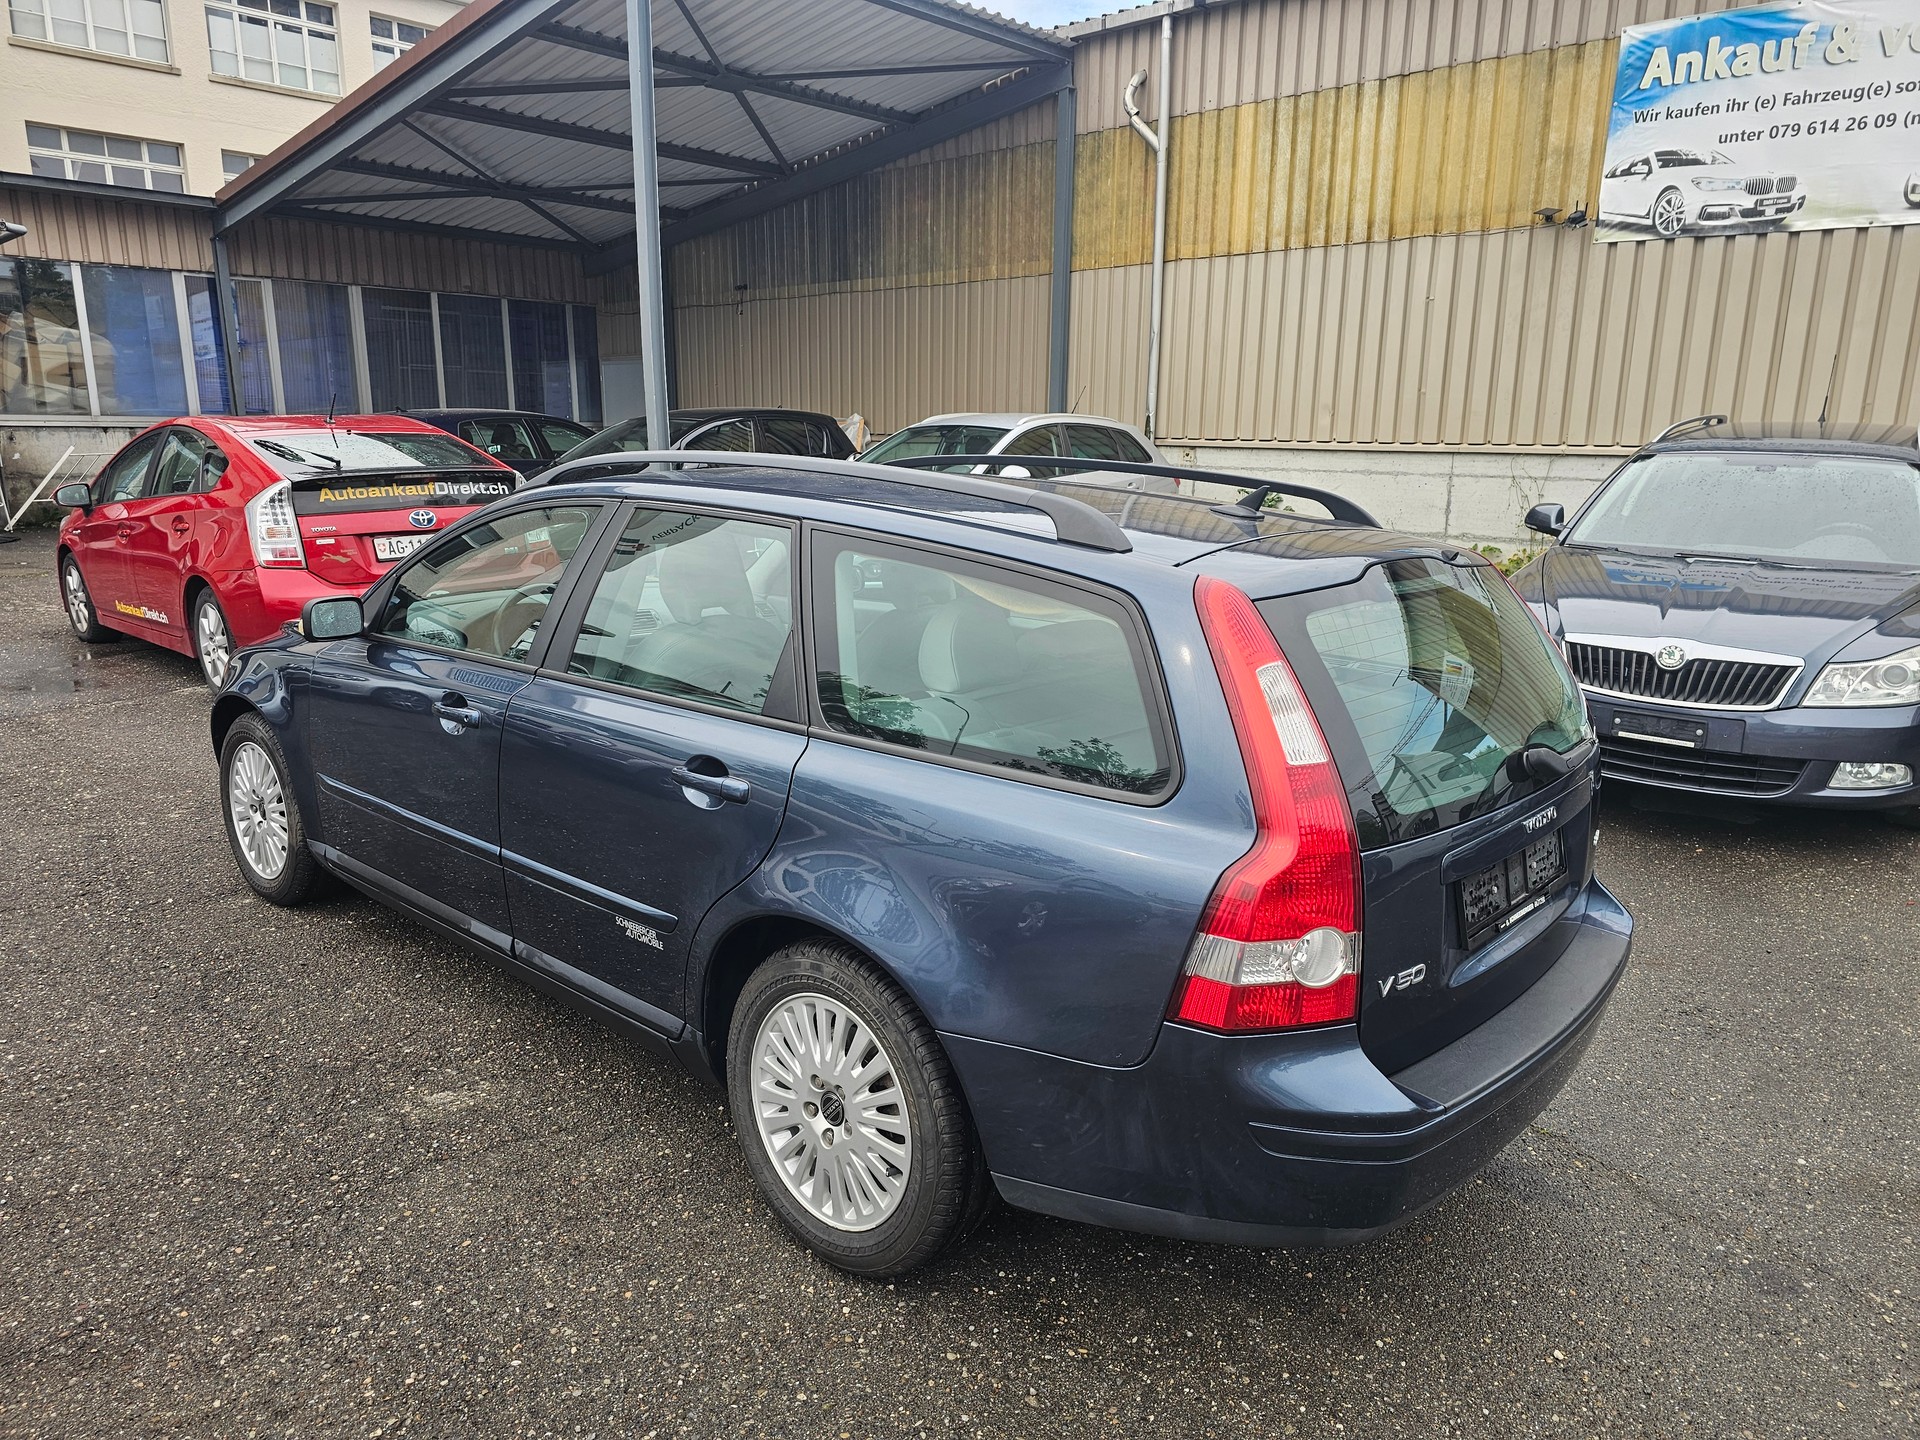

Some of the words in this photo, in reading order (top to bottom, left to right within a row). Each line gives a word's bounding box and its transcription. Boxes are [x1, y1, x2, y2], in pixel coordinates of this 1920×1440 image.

[1639, 21, 1821, 90] Ankauf
[1824, 20, 1860, 65] &
[1633, 110, 1661, 124] Wir
[1665, 102, 1720, 120] kaufen
[1725, 98, 1750, 113] ihr
[1754, 94, 1777, 113] (e)
[1782, 80, 1892, 107] Fahrzeug(e)
[1894, 80, 1920, 94] so
[1718, 129, 1765, 144] unter
[1768, 122, 1802, 140] 079
[1806, 118, 1840, 136] 614
[1844, 115, 1869, 132] 26
[1873, 112, 1898, 129] 09
[319, 481, 510, 503] AutoankaufDirekt.ch
[310, 525, 337, 534] TOYOTA
[1520, 804, 1558, 834] VOLVO
[625, 928, 664, 951] AUTOMOBILE
